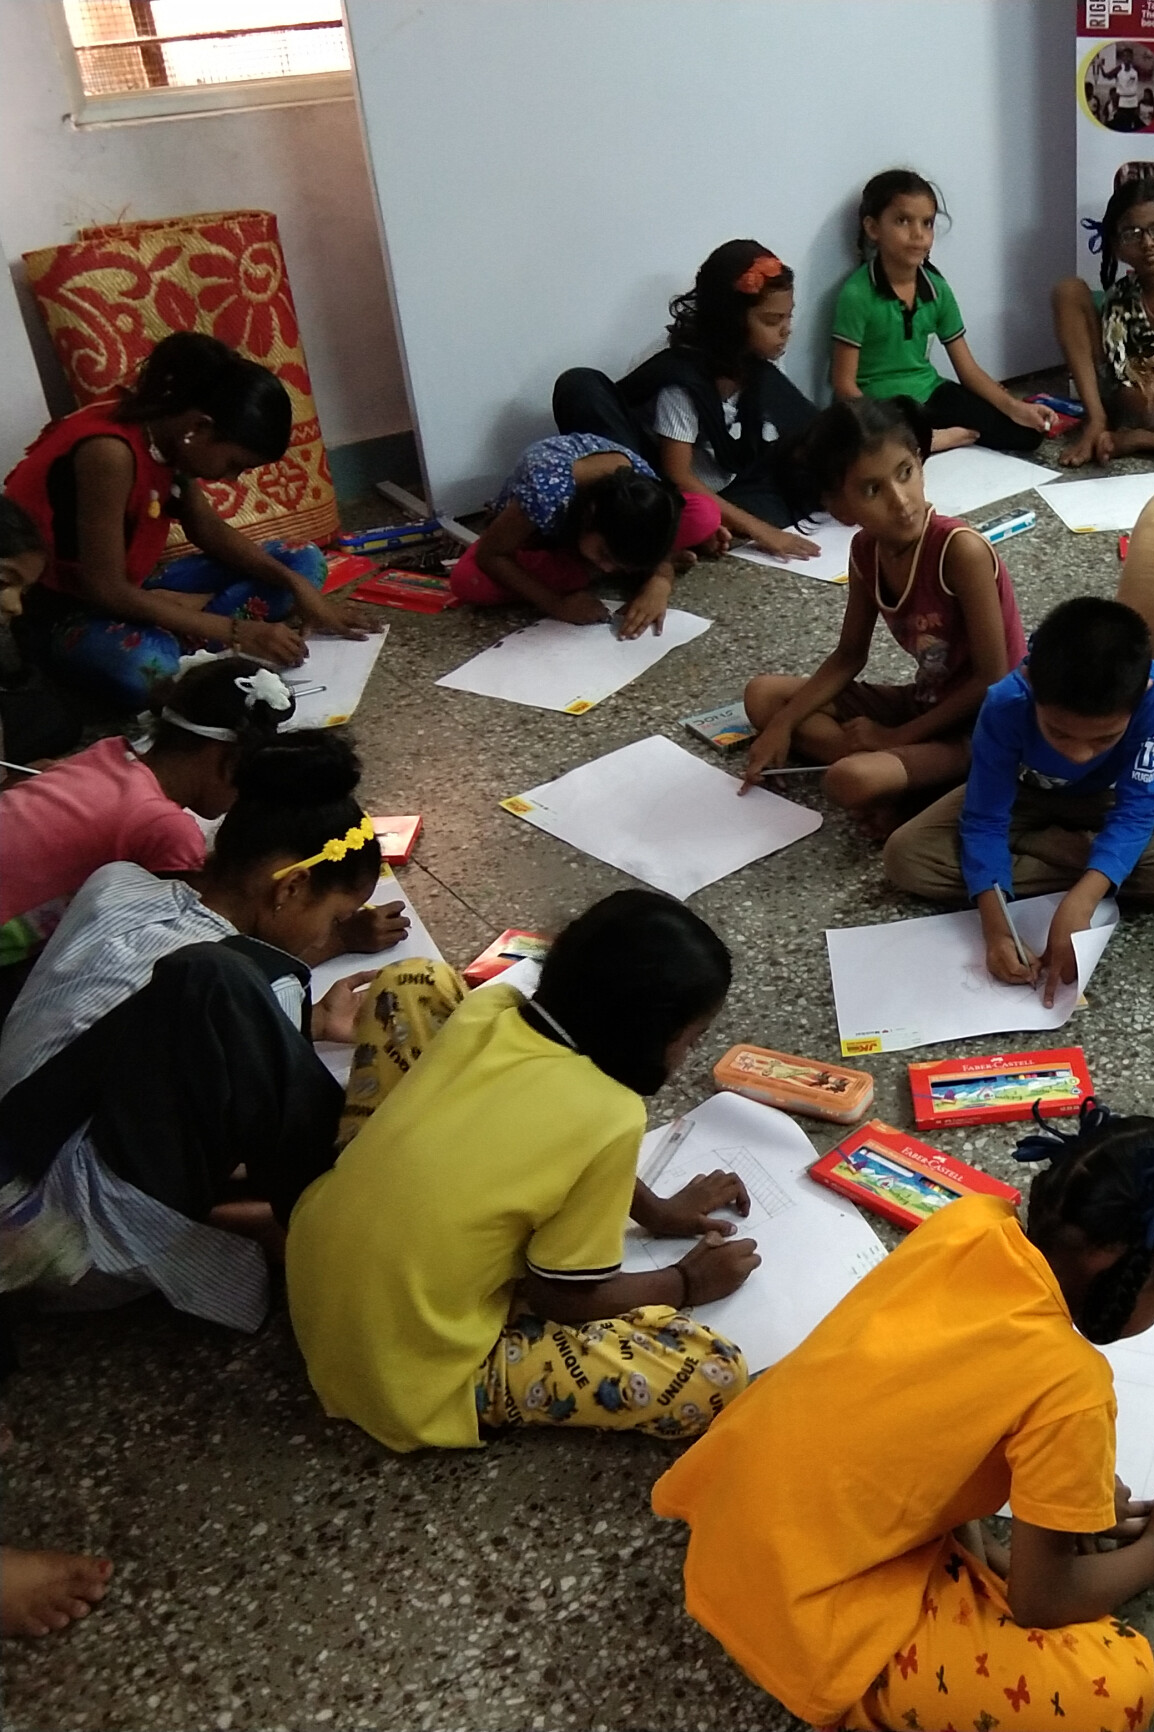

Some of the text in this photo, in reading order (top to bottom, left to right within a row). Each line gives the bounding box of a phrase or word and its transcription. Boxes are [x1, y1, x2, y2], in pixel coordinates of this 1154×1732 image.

[1090, 0, 1106, 27] RIG
[962, 1059, 1035, 1072] FABER-CASTELL
[901, 1147, 964, 1182] FABER-CASTELL
[552, 1331, 590, 1390] UNIQUE
[656, 1356, 699, 1407] UNIQUE
